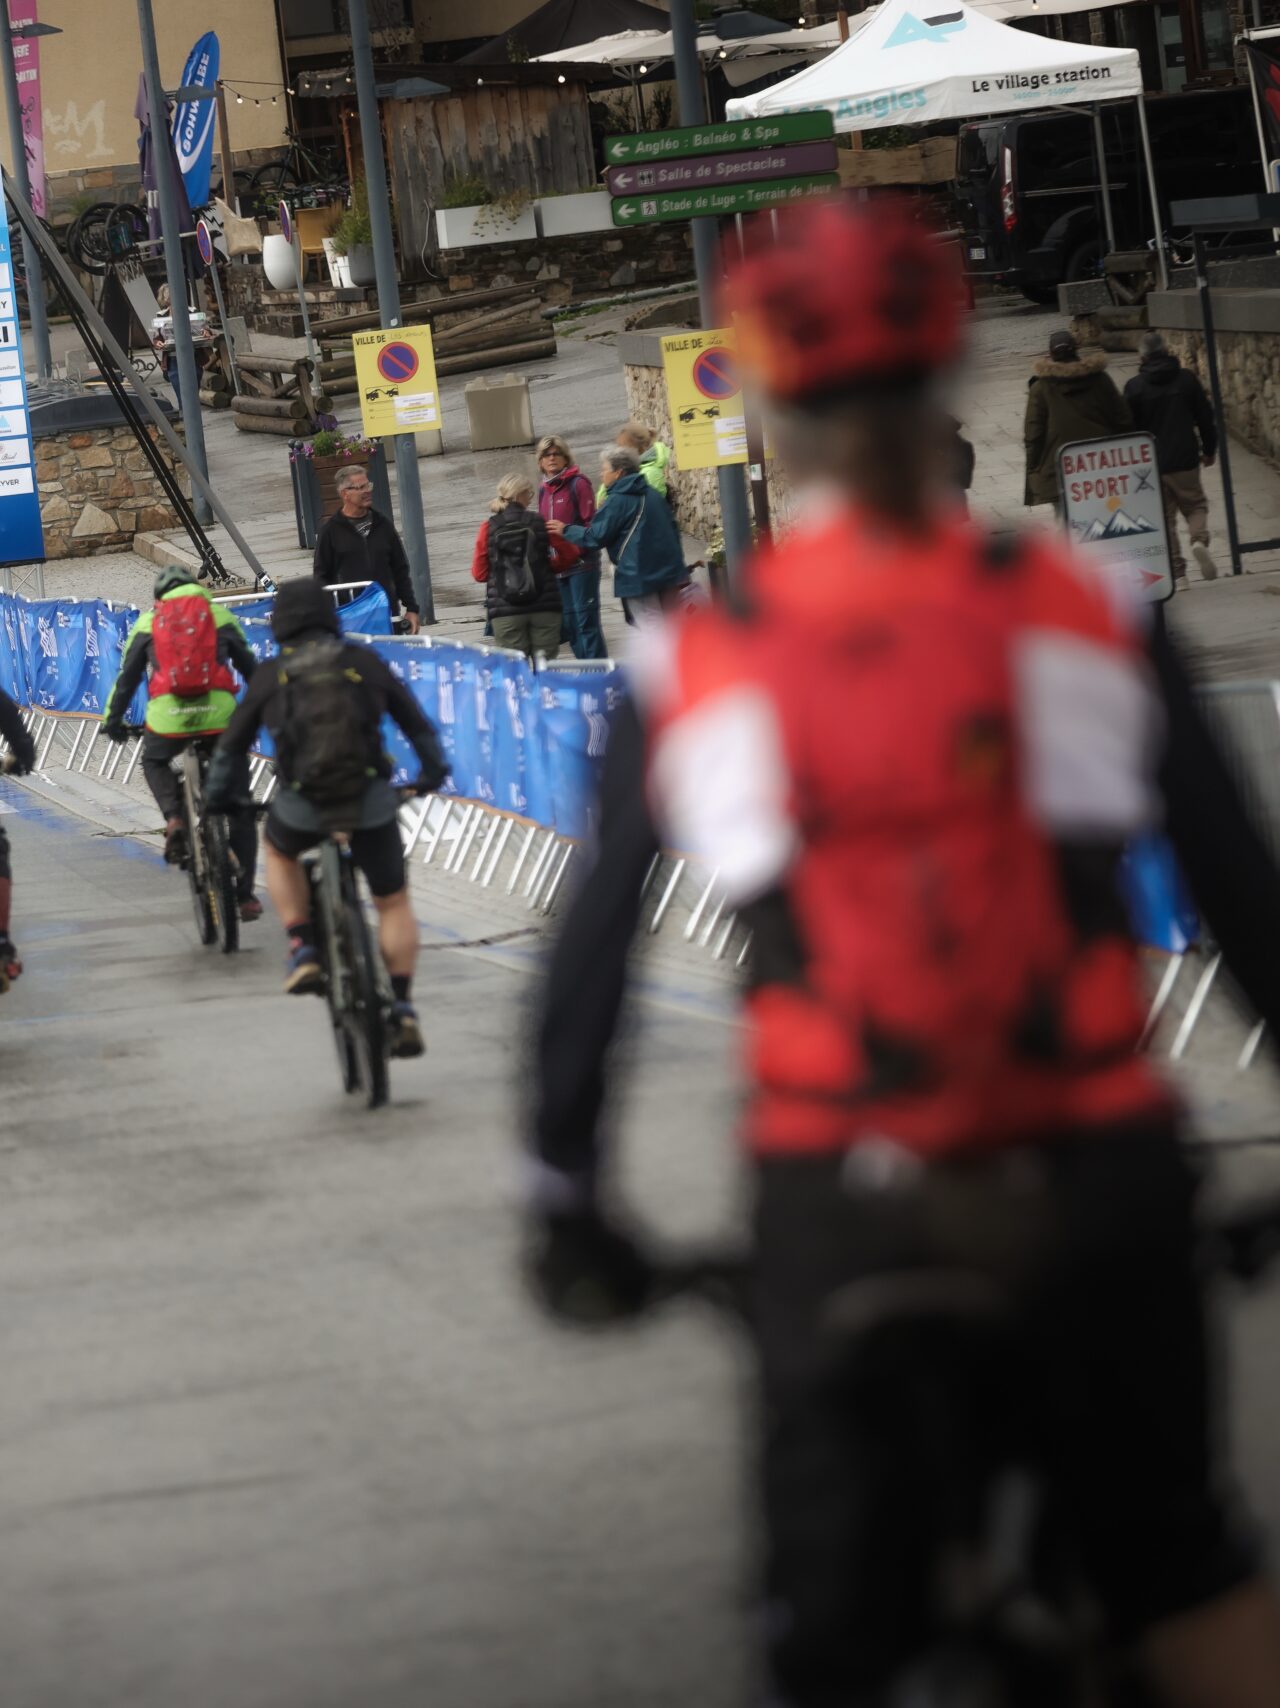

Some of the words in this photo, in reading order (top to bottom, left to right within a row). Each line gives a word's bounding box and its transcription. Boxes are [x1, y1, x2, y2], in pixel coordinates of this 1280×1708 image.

[972, 80, 989, 93] Le
[995, 70, 1050, 91] village
[1055, 64, 1111, 83] station
[183, 53, 209, 153] SCHWLBE
[836, 87, 927, 119] Angles
[634, 138, 680, 155] Angléo
[693, 131, 737, 147] Balnéo
[741, 128, 751, 140] &
[754, 126, 780, 140] Spa
[658, 168, 692, 182] Salle
[696, 165, 712, 177] de
[716, 157, 786, 176] Spectacles
[661, 200, 692, 212] Stade
[695, 197, 708, 208] de
[712, 192, 736, 209] Luge
[747, 186, 786, 202] Terrain
[355, 336, 375, 346] VILLE
[377, 335, 386, 343] DE
[664, 340, 690, 352] VILLE
[691, 338, 703, 348] DE
[1062, 444, 1152, 475] BATAILLE
[1071, 475, 1130, 502] SPORT
